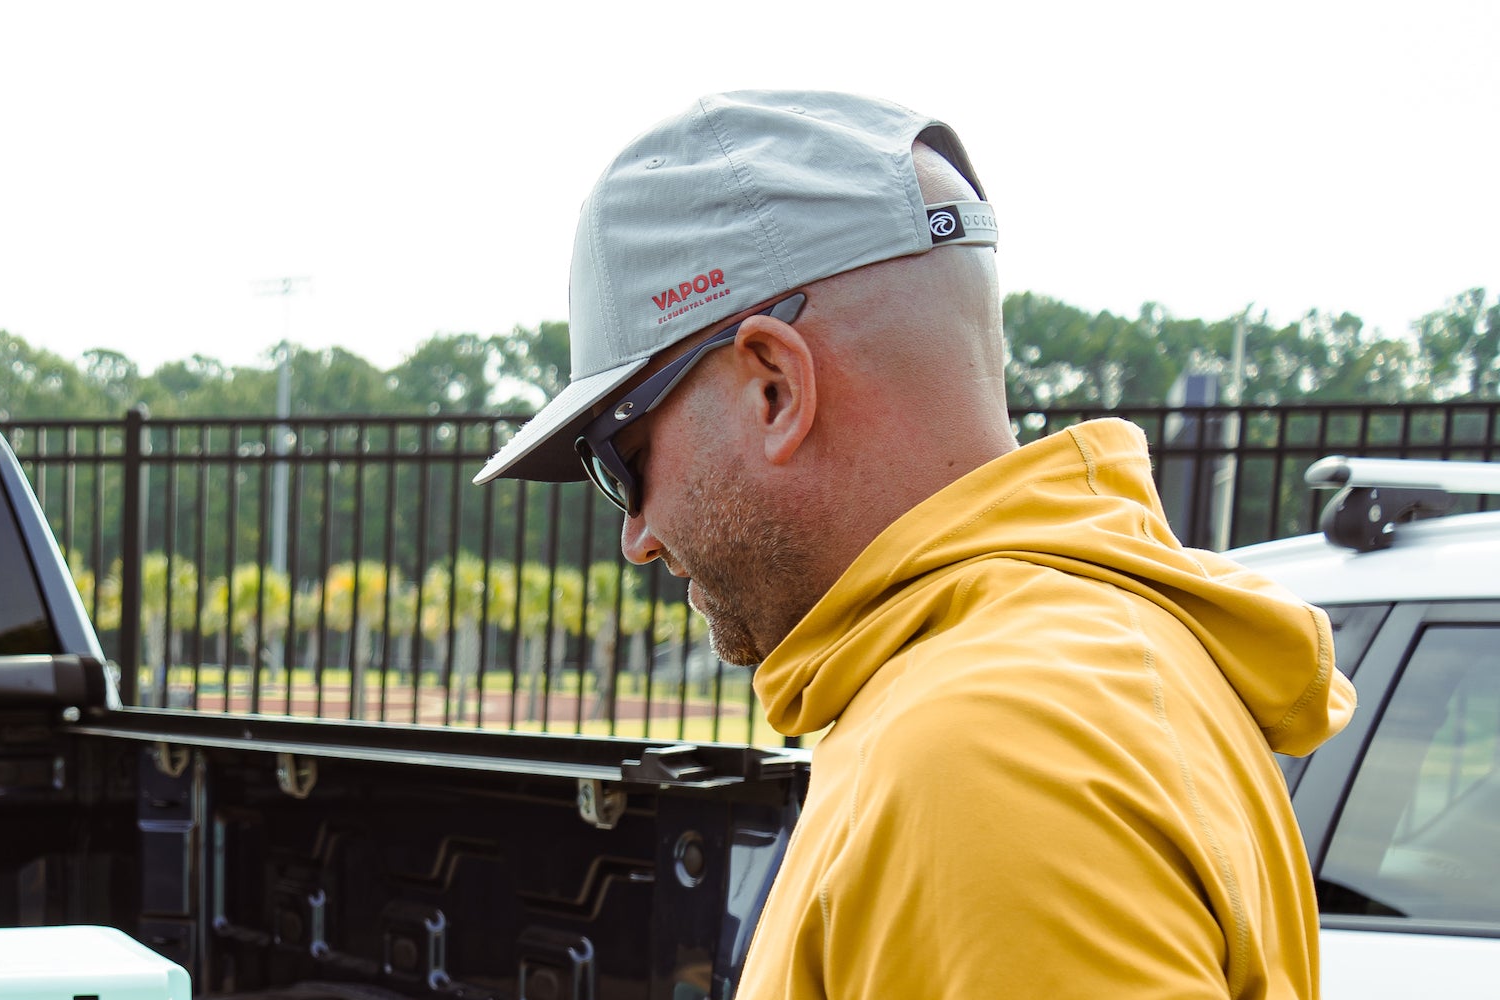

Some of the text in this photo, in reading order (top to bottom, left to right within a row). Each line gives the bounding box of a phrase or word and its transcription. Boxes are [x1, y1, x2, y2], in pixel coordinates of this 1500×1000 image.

[652, 268, 725, 310] VAPOR
[657, 287, 731, 325] ELEMENTAL WEAR
